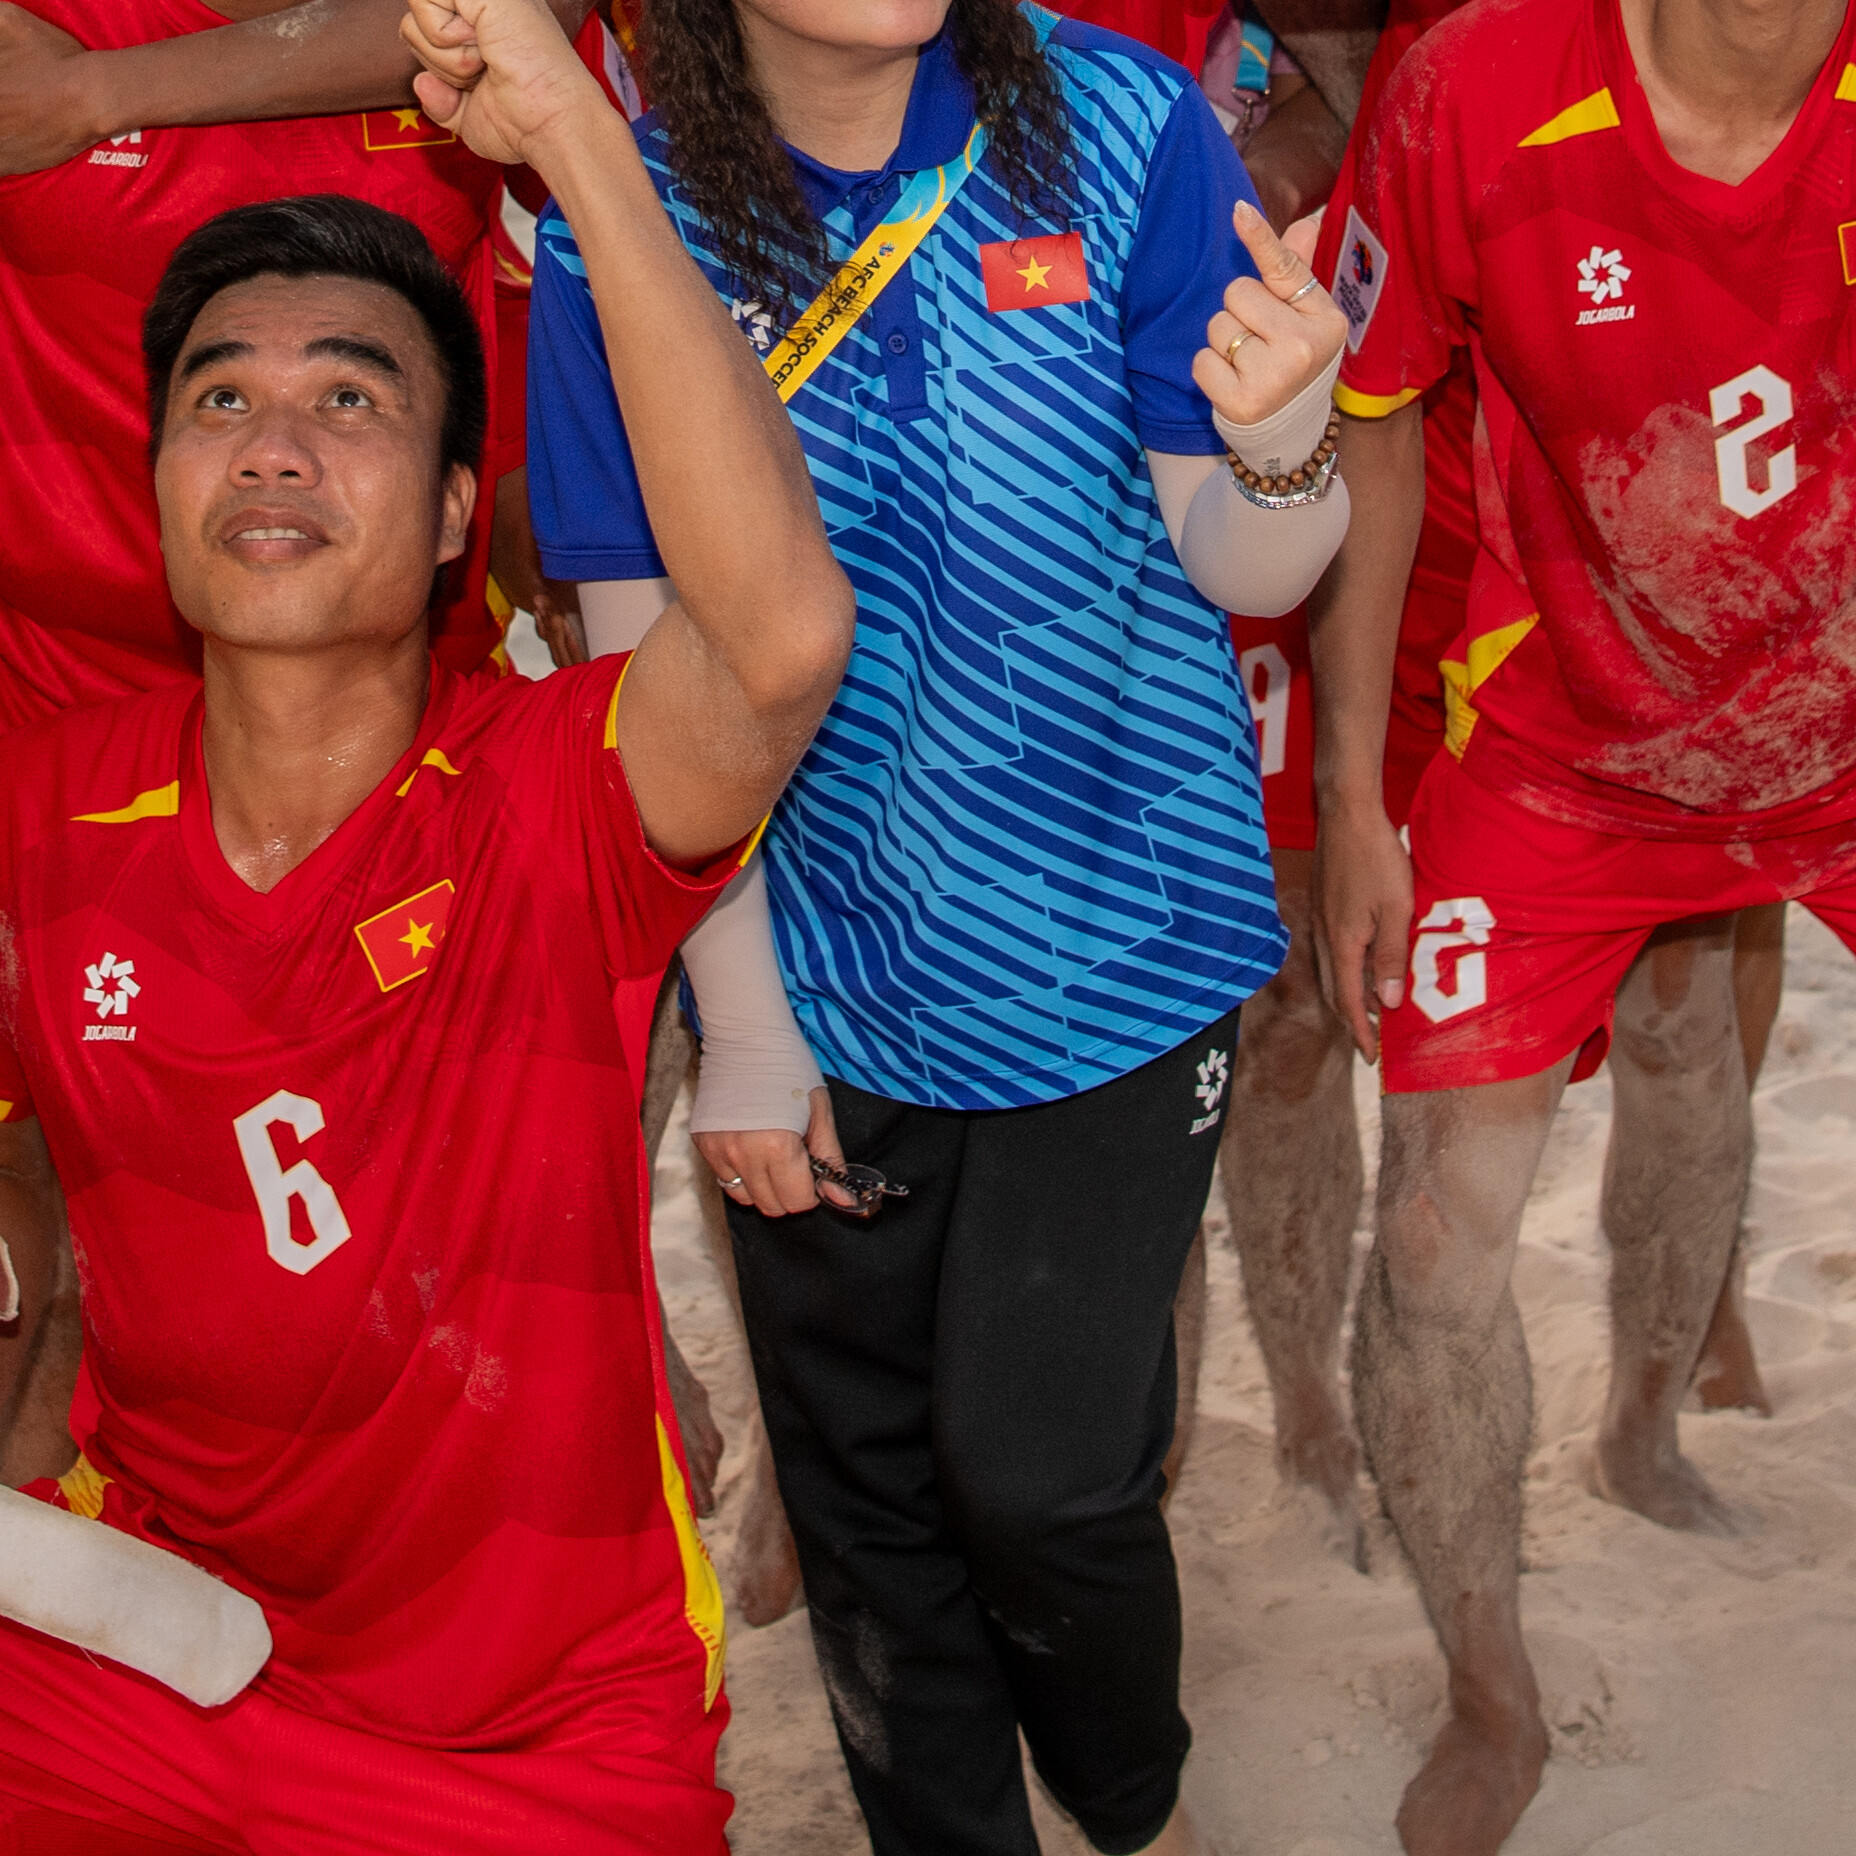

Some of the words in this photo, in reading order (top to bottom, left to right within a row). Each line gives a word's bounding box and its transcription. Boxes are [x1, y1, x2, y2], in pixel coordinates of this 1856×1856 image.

[812, 285, 858, 337] BEACH
[852, 255, 881, 289] AFC
[1709, 363, 1797, 519] 2
[1411, 896, 1496, 1023] 2
[233, 1088, 351, 1275] 6
